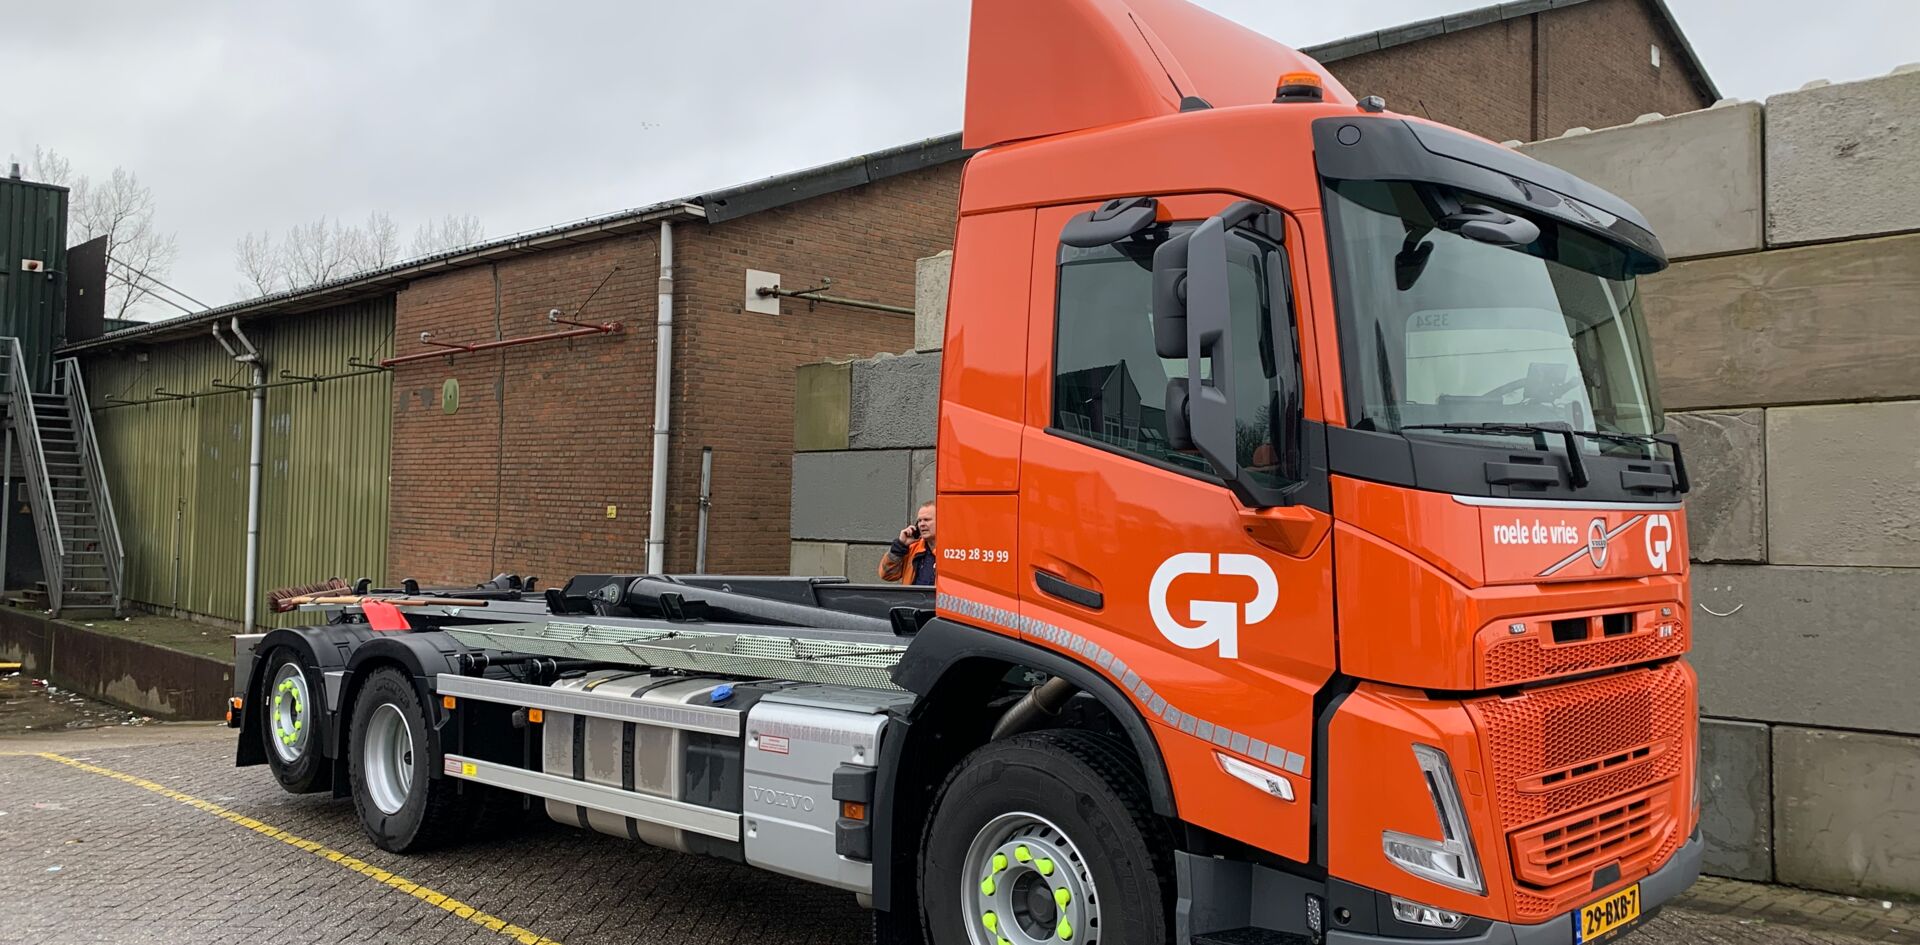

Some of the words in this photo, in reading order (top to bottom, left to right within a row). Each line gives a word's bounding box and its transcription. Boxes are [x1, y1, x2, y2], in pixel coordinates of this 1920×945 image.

[1493, 519, 1530, 545] roele
[1532, 519, 1548, 545] de
[1550, 519, 1579, 545] vries
[944, 548, 966, 561] 0229
[968, 548, 980, 560] 28
[982, 549, 994, 562] 39
[996, 550, 1009, 563] 99
[748, 785, 815, 812] VOLVO
[1586, 889, 1636, 936] 29-BXB-7
